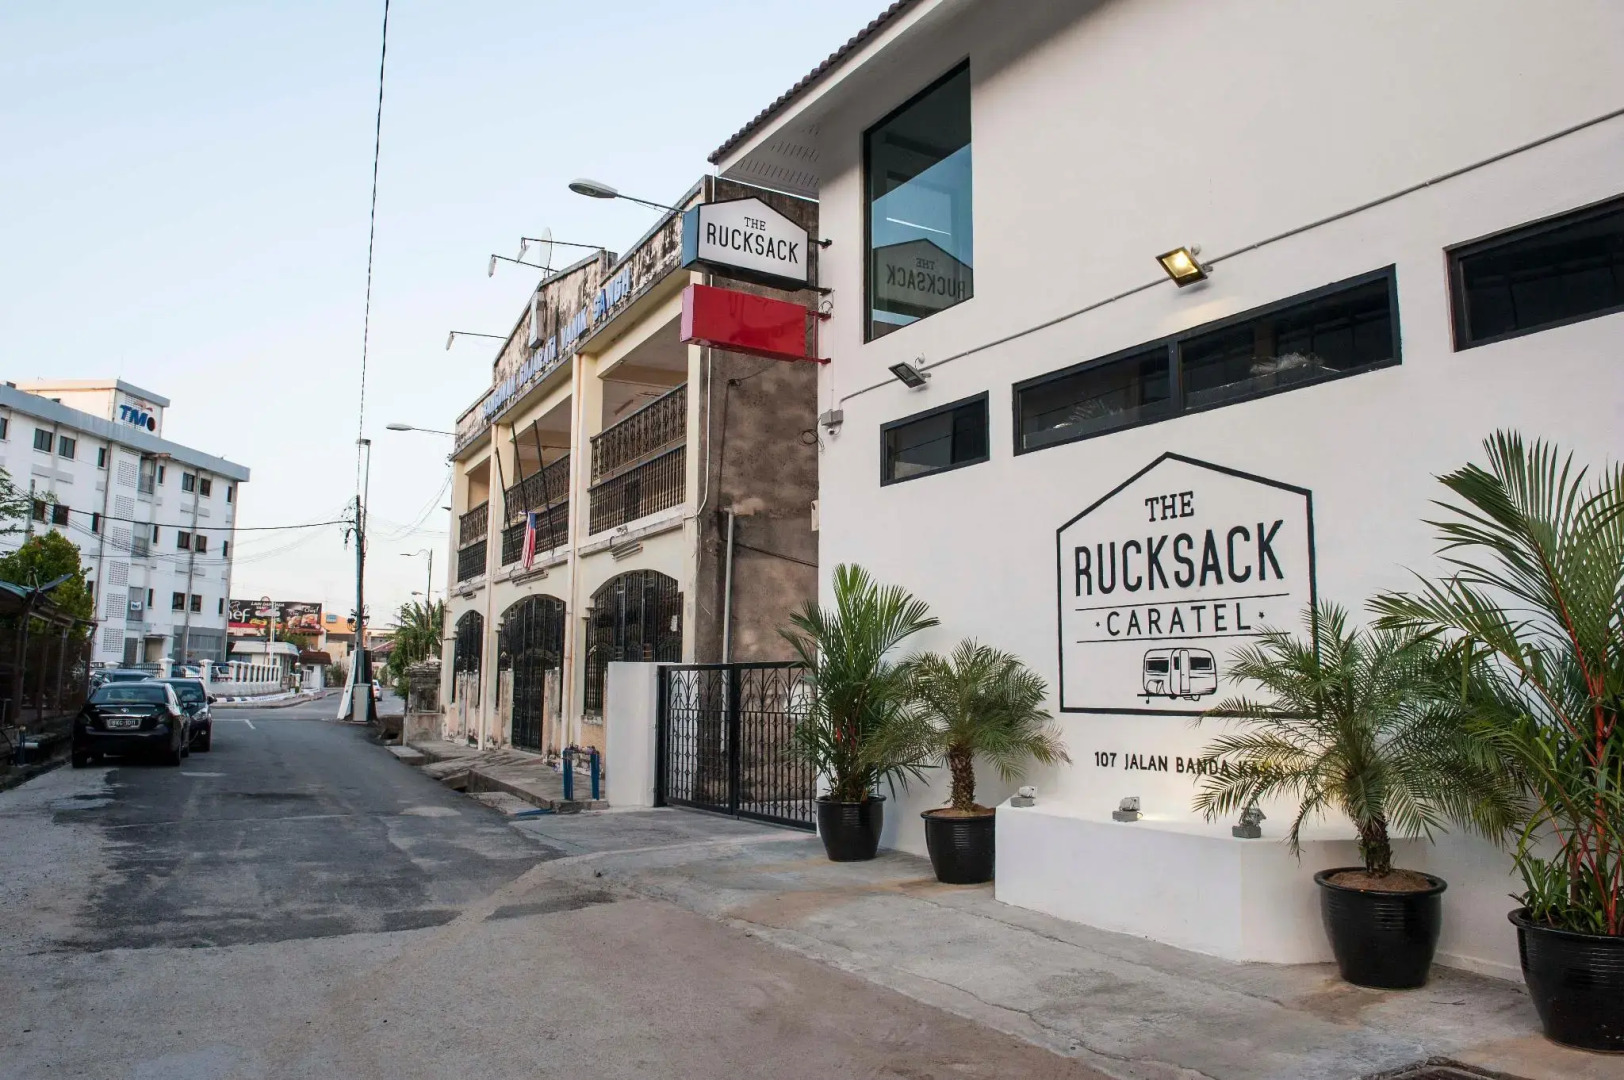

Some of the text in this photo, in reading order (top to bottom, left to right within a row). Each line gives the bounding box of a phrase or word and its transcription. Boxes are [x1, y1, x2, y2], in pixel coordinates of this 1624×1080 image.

[744, 217, 766, 231] THE
[706, 222, 799, 264] RUCKSACK
[119, 404, 148, 427] TM
[1145, 491, 1194, 522] THE
[1075, 519, 1284, 597] RUCKSACK
[1106, 602, 1251, 636] CARATEL
[1095, 752, 1117, 768] 107
[1124, 754, 1168, 772] JALAN
